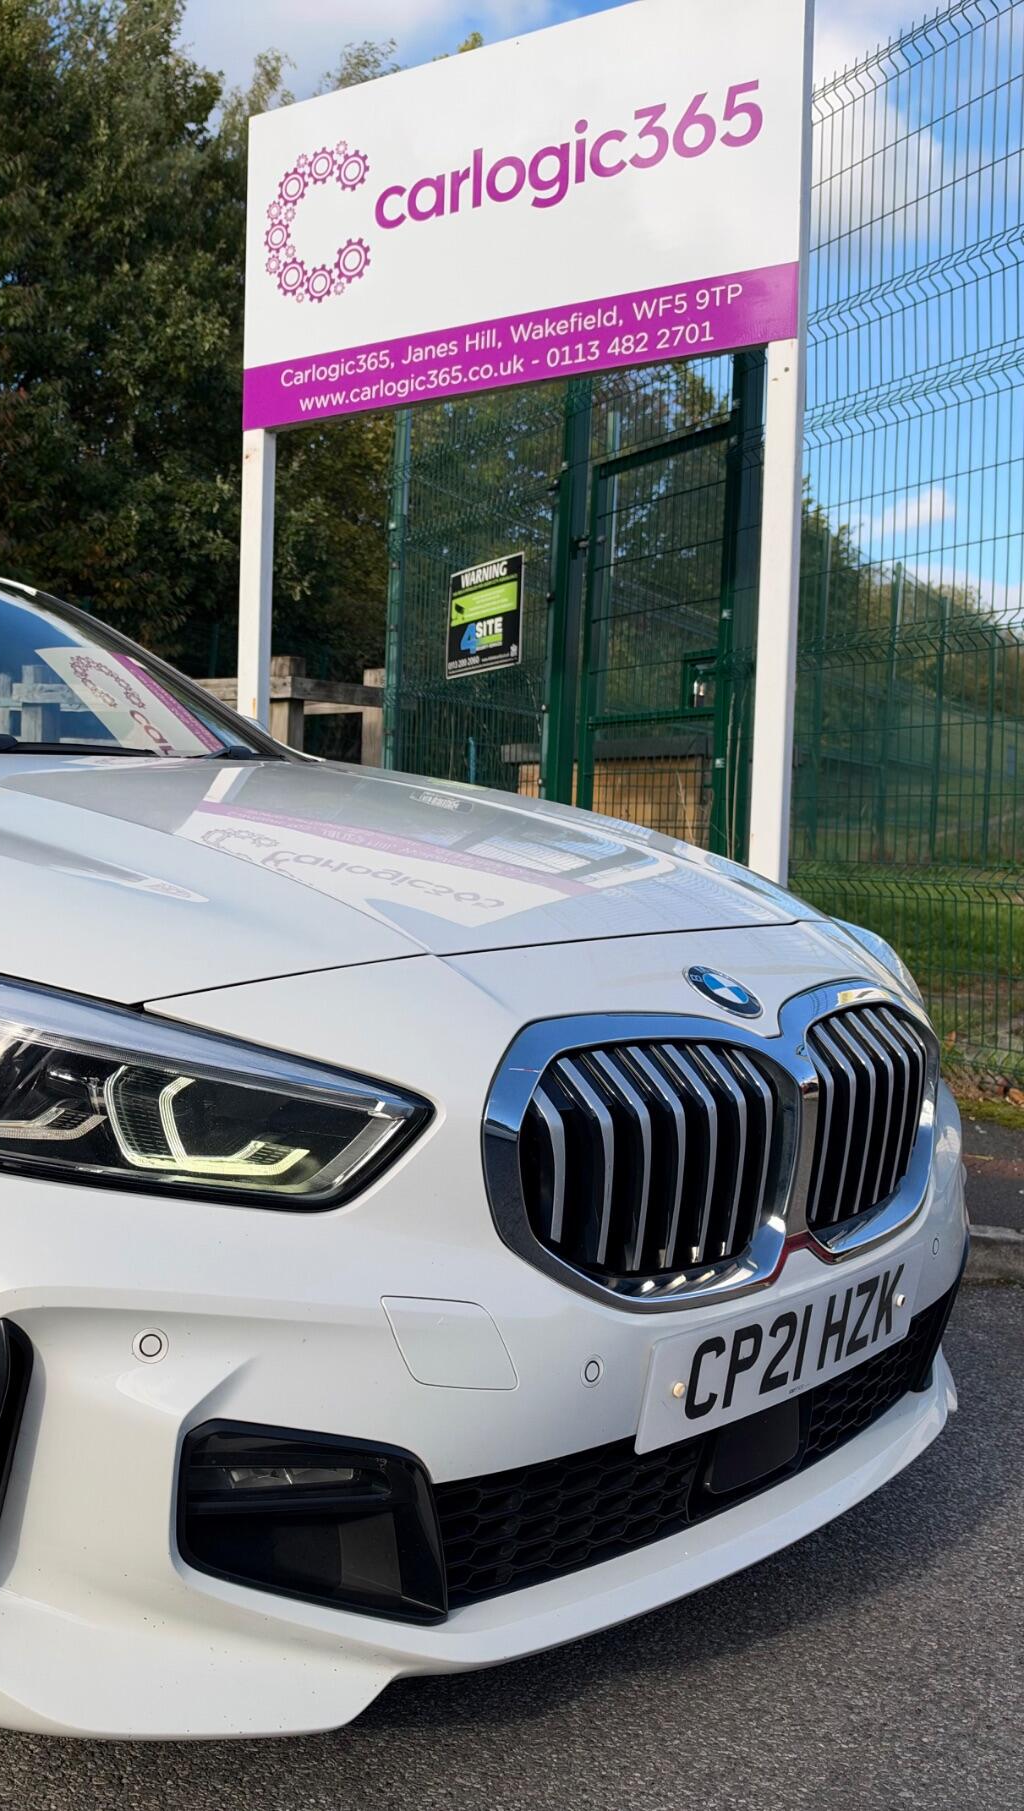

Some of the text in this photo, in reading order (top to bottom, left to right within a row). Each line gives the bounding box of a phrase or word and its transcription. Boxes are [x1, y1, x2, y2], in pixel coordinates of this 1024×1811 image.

[375, 79, 764, 229] carlogic365
[280, 283, 743, 388] Carlogic365, Janes Hill, Wakefield, WF5 9TP
[299, 354, 524, 412] www.carlogic365.co.uk
[546, 340, 600, 368] 0113
[607, 332, 649, 356] 482
[655, 321, 714, 349] 2701
[461, 561, 508, 589] WARNING
[684, 1263, 906, 1421] CP21 HZK
